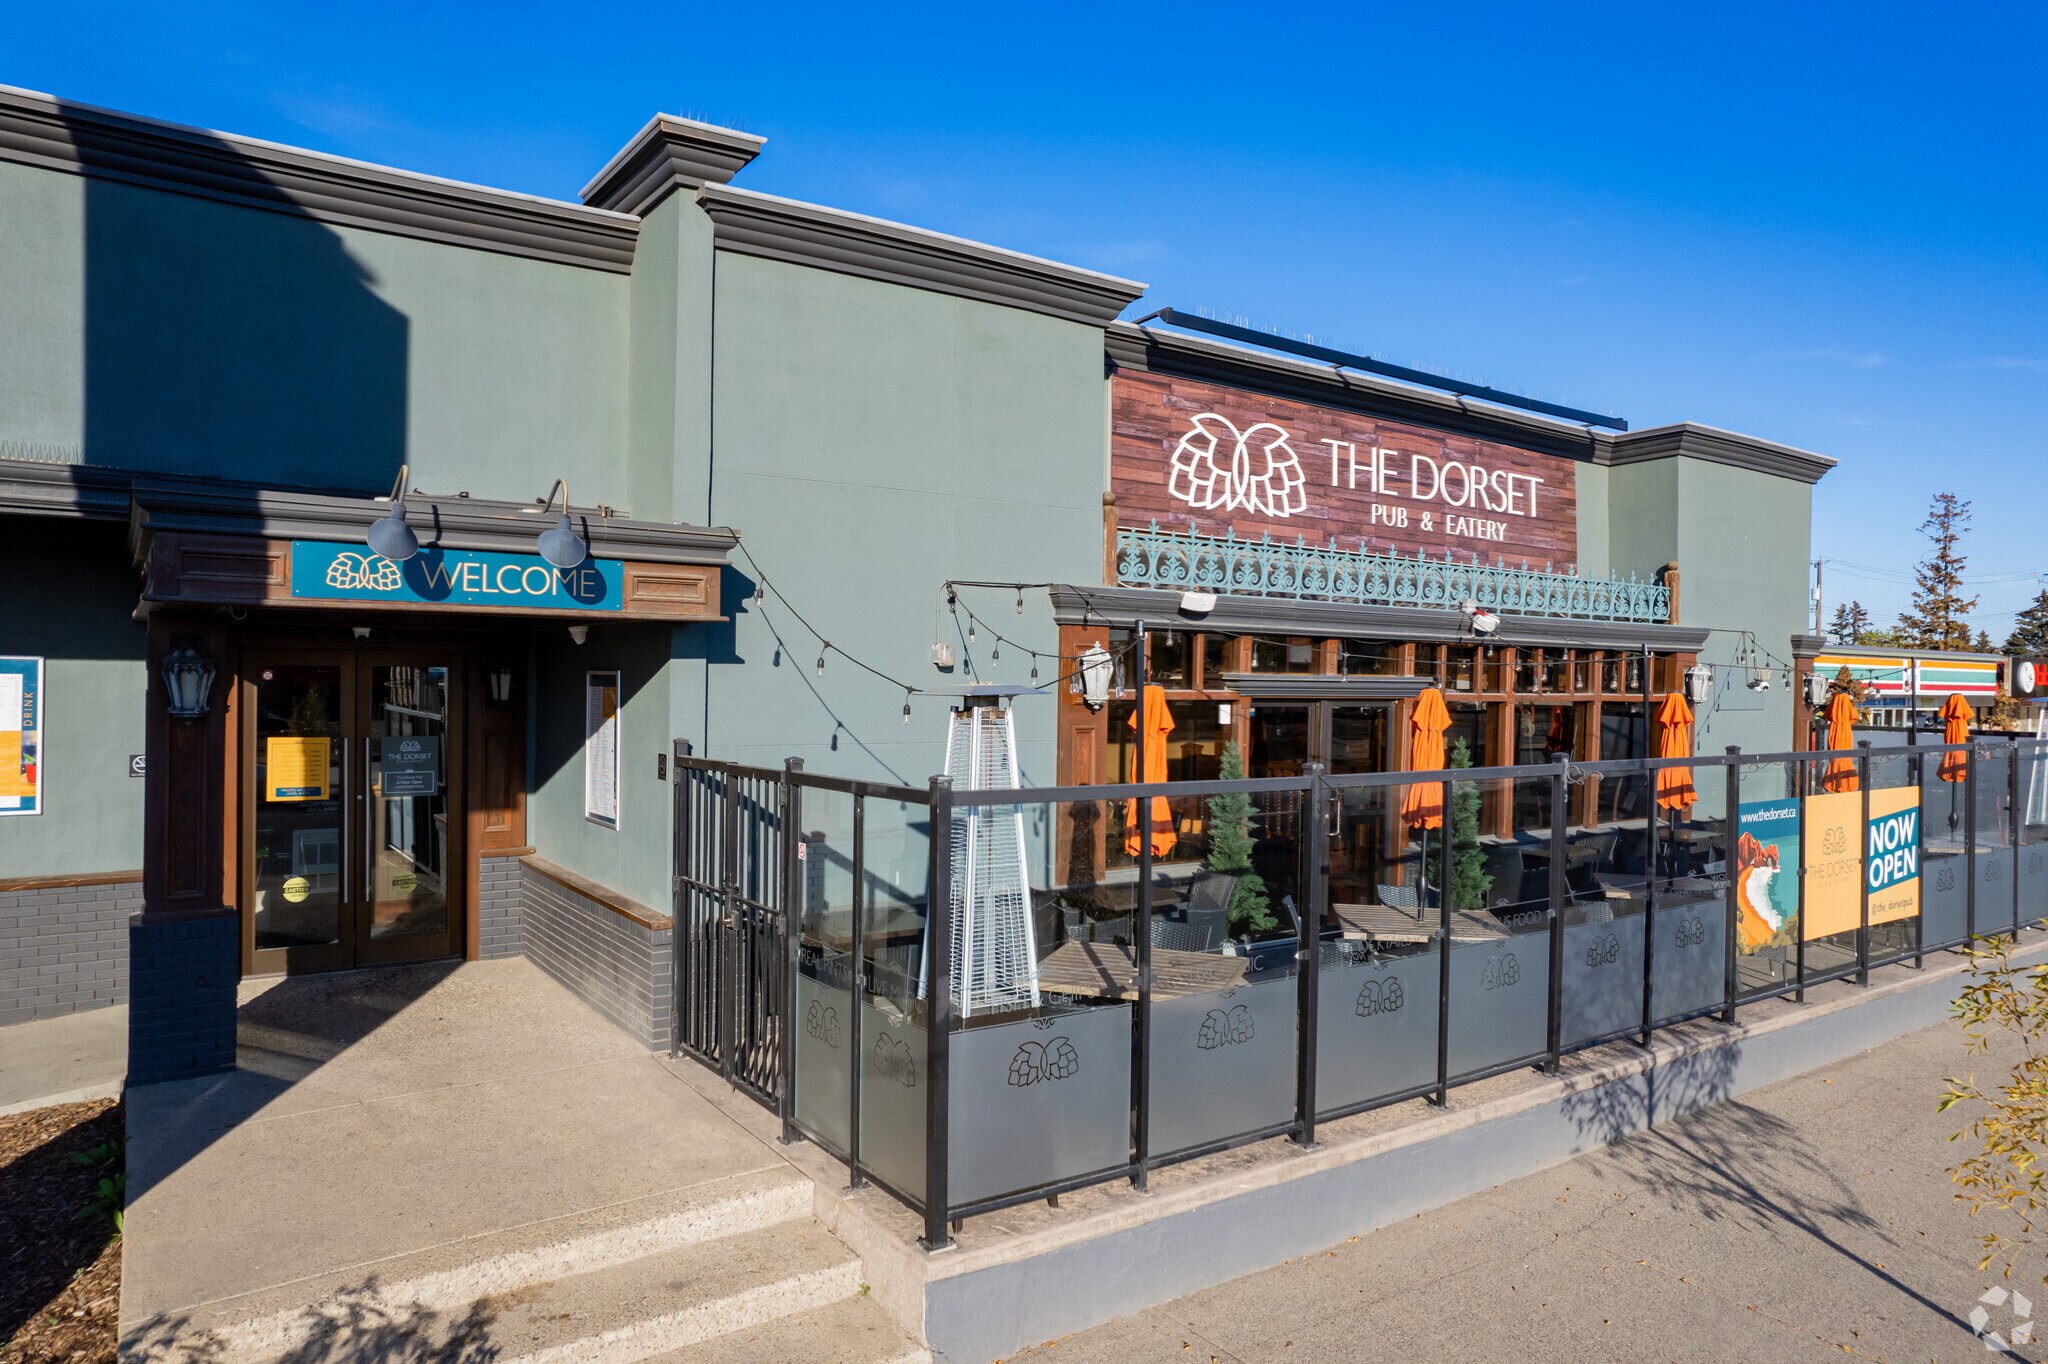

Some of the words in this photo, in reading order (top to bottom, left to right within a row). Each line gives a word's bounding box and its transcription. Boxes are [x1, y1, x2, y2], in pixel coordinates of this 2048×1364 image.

[1321, 438, 1399, 496] THE
[1412, 455, 1544, 518] DORSET
[1370, 503, 1409, 529] PUB
[1420, 511, 1434, 533] &
[1446, 513, 1508, 542] EATERY
[420, 560, 596, 597] WELCOME
[23, 691, 34, 727] DRINK
[403, 752, 432, 760] DORSET
[1740, 806, 1797, 824] www.thedorset.ca
[1869, 811, 1917, 857] NOW
[1808, 863, 1825, 881] THE
[1826, 857, 1860, 878] DORSET
[1868, 845, 1917, 888] OPEN
[801, 948, 822, 971] REAL
[868, 974, 888, 1000] LIVE
